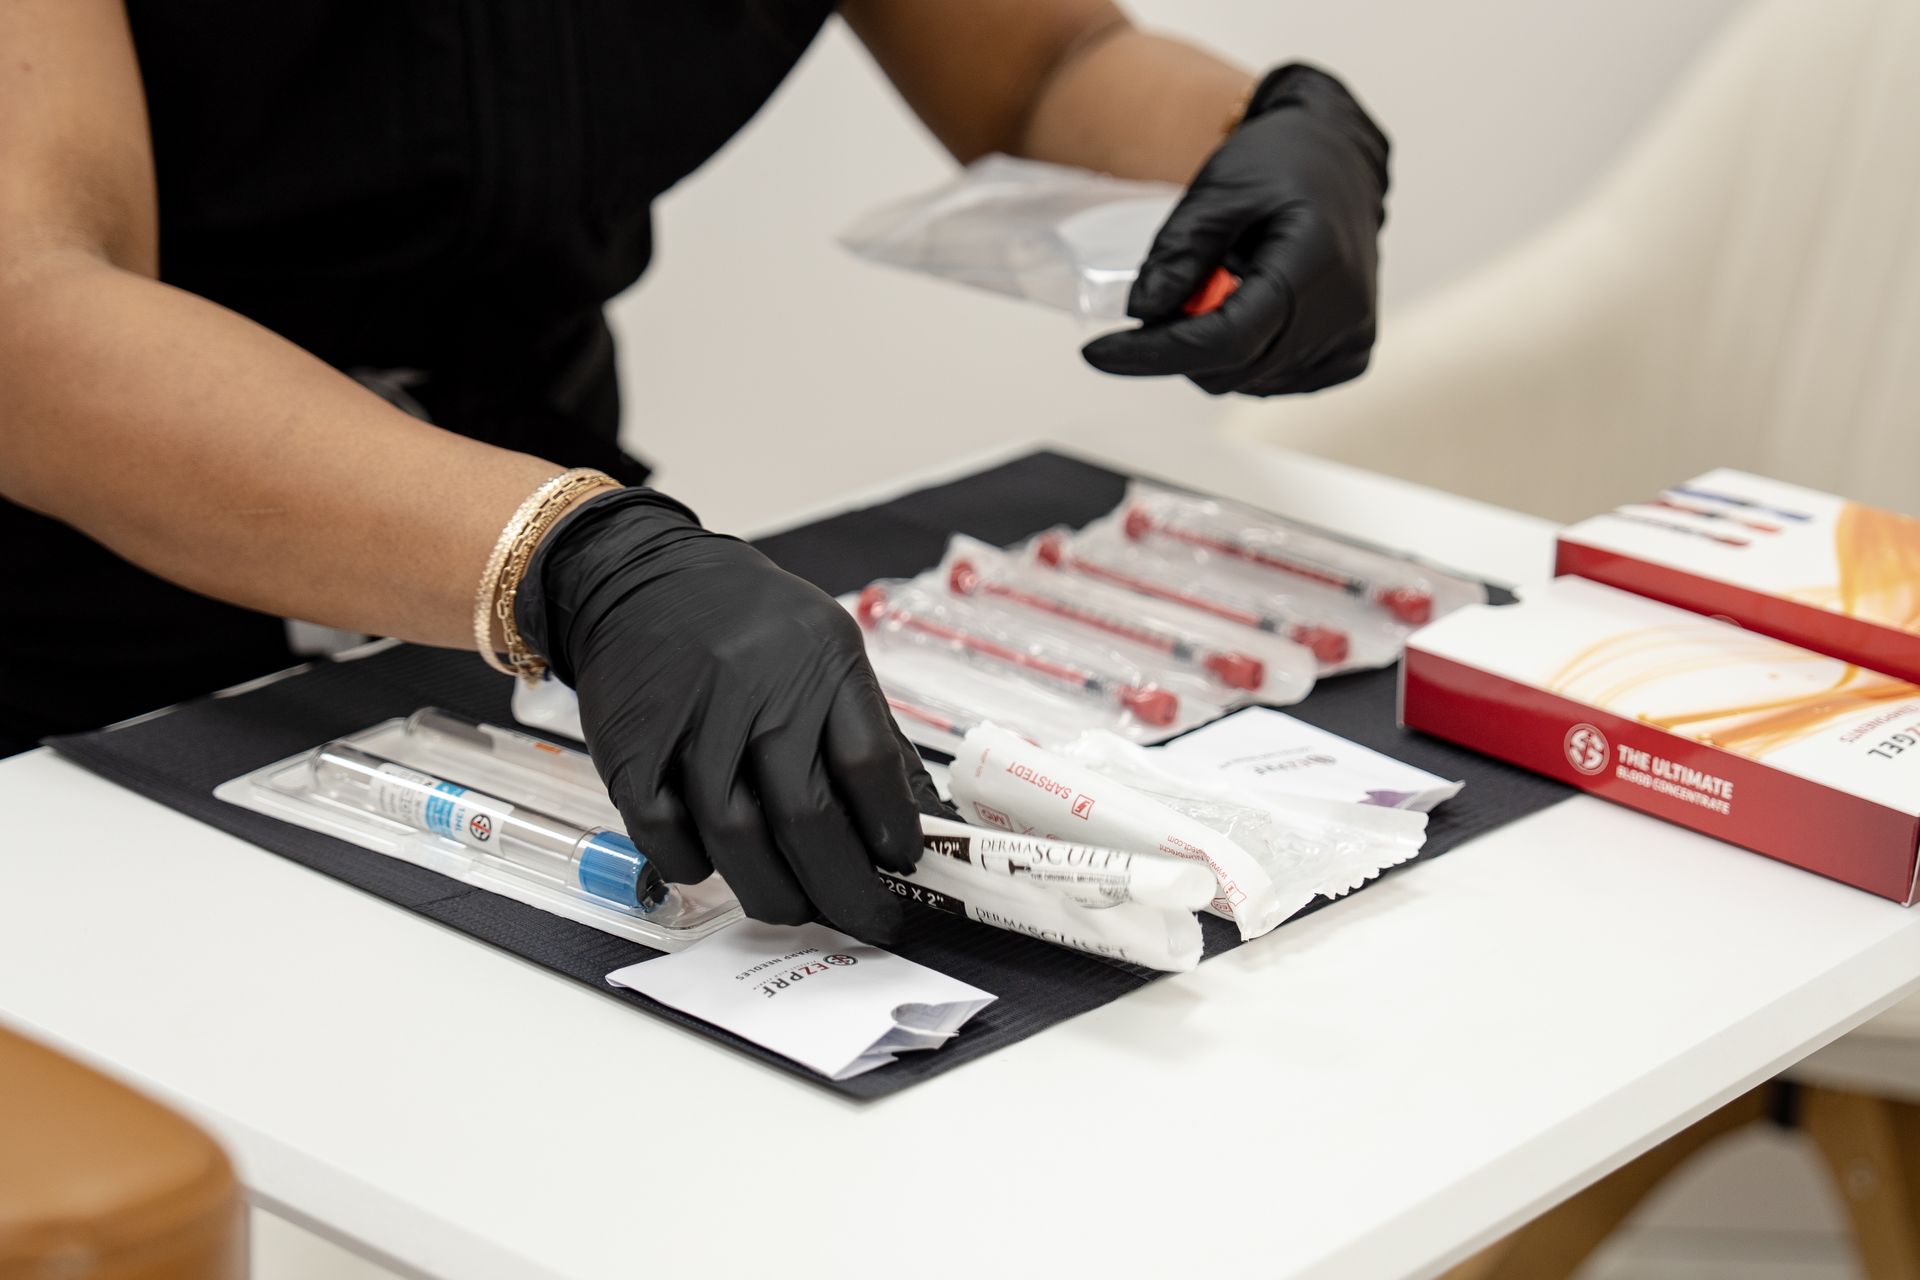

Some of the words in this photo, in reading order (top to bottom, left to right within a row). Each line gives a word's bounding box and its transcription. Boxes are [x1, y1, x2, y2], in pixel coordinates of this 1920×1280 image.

[1006, 762, 1072, 799] SARSTEDT
[1616, 765, 1652, 788] BLOOD
[1652, 777, 1731, 815] CONCENTRATE
[1617, 744, 1651, 771] THE
[1652, 756, 1734, 800] ULTIMATE
[880, 876, 907, 896] 2G
[911, 887, 923, 902] X
[926, 892, 945, 907] 2"
[735, 958, 782, 981] NEEDLES
[784, 947, 819, 960] SHARP
[763, 962, 830, 998] EZPRF
